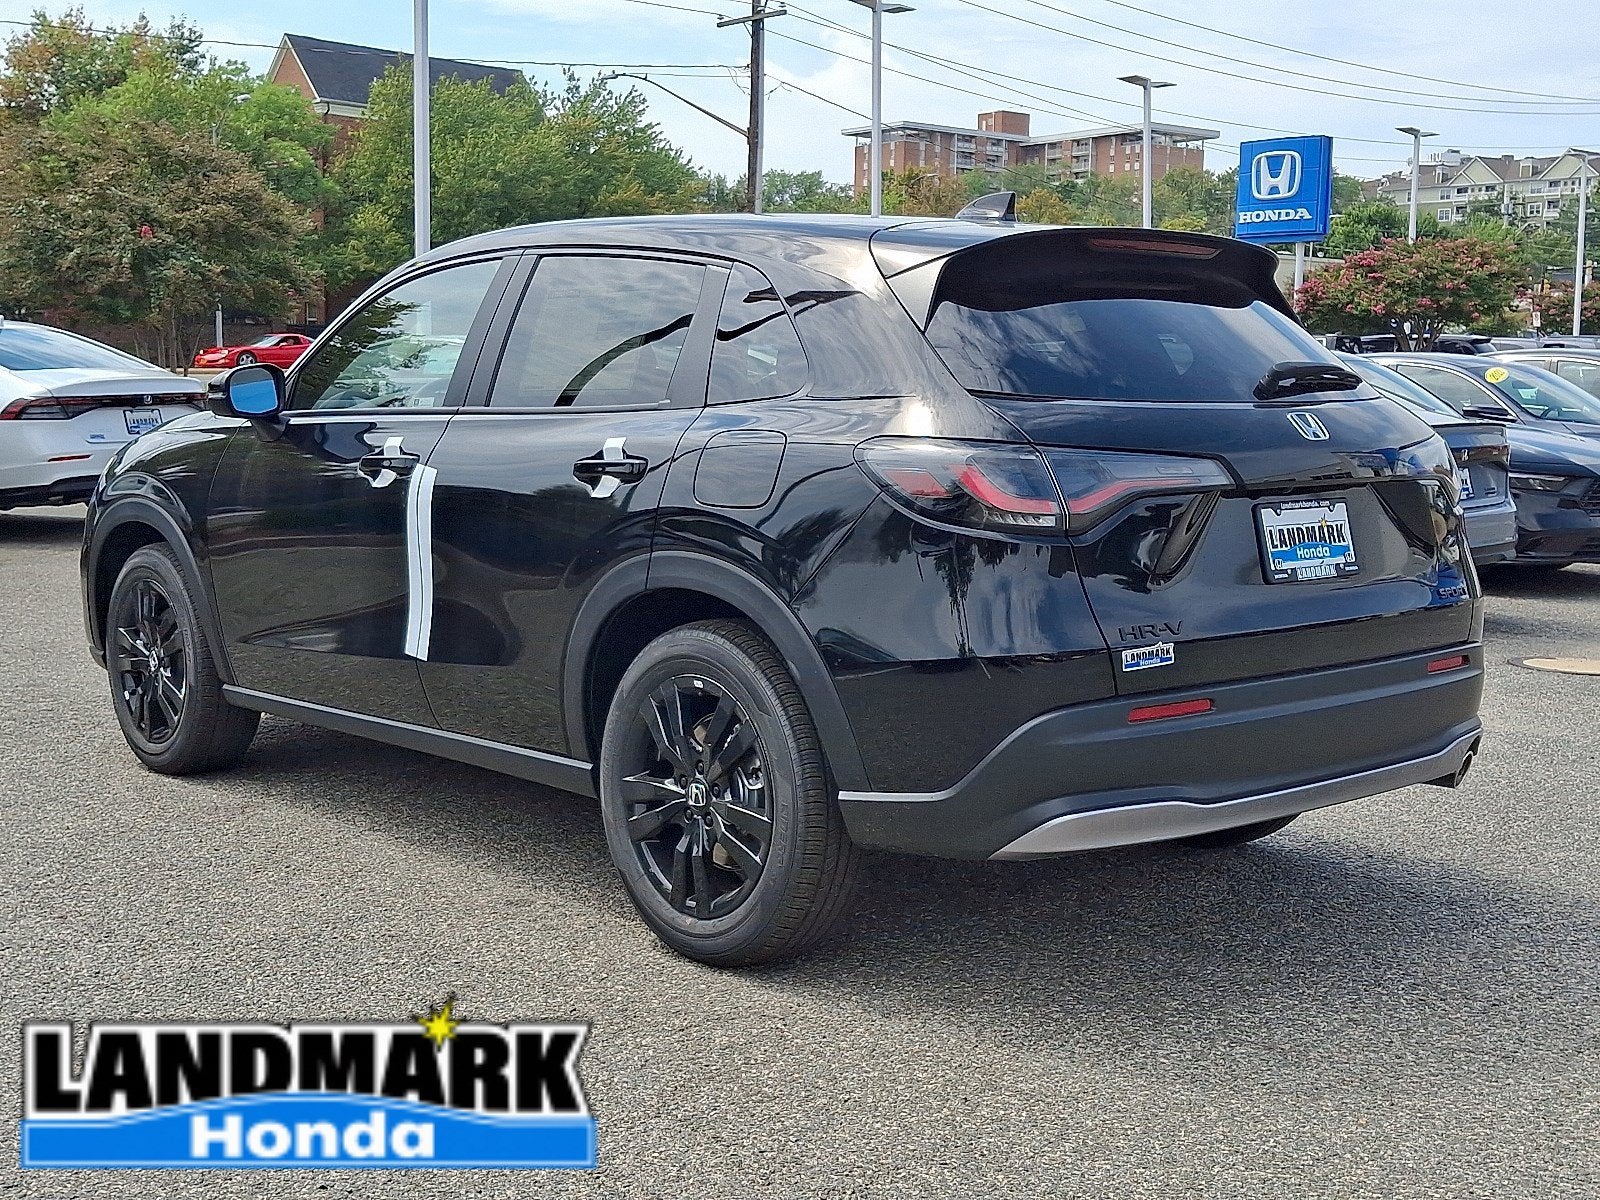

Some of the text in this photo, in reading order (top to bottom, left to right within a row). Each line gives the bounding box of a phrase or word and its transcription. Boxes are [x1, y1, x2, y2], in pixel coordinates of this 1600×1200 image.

[1239, 208, 1312, 224] HONDA
[1268, 523, 1347, 550] LANDMARK
[1296, 545, 1331, 559] Honda
[1118, 620, 1182, 642] HR-V
[1125, 646, 1172, 664] LANDMARK
[1140, 657, 1161, 666] Honda
